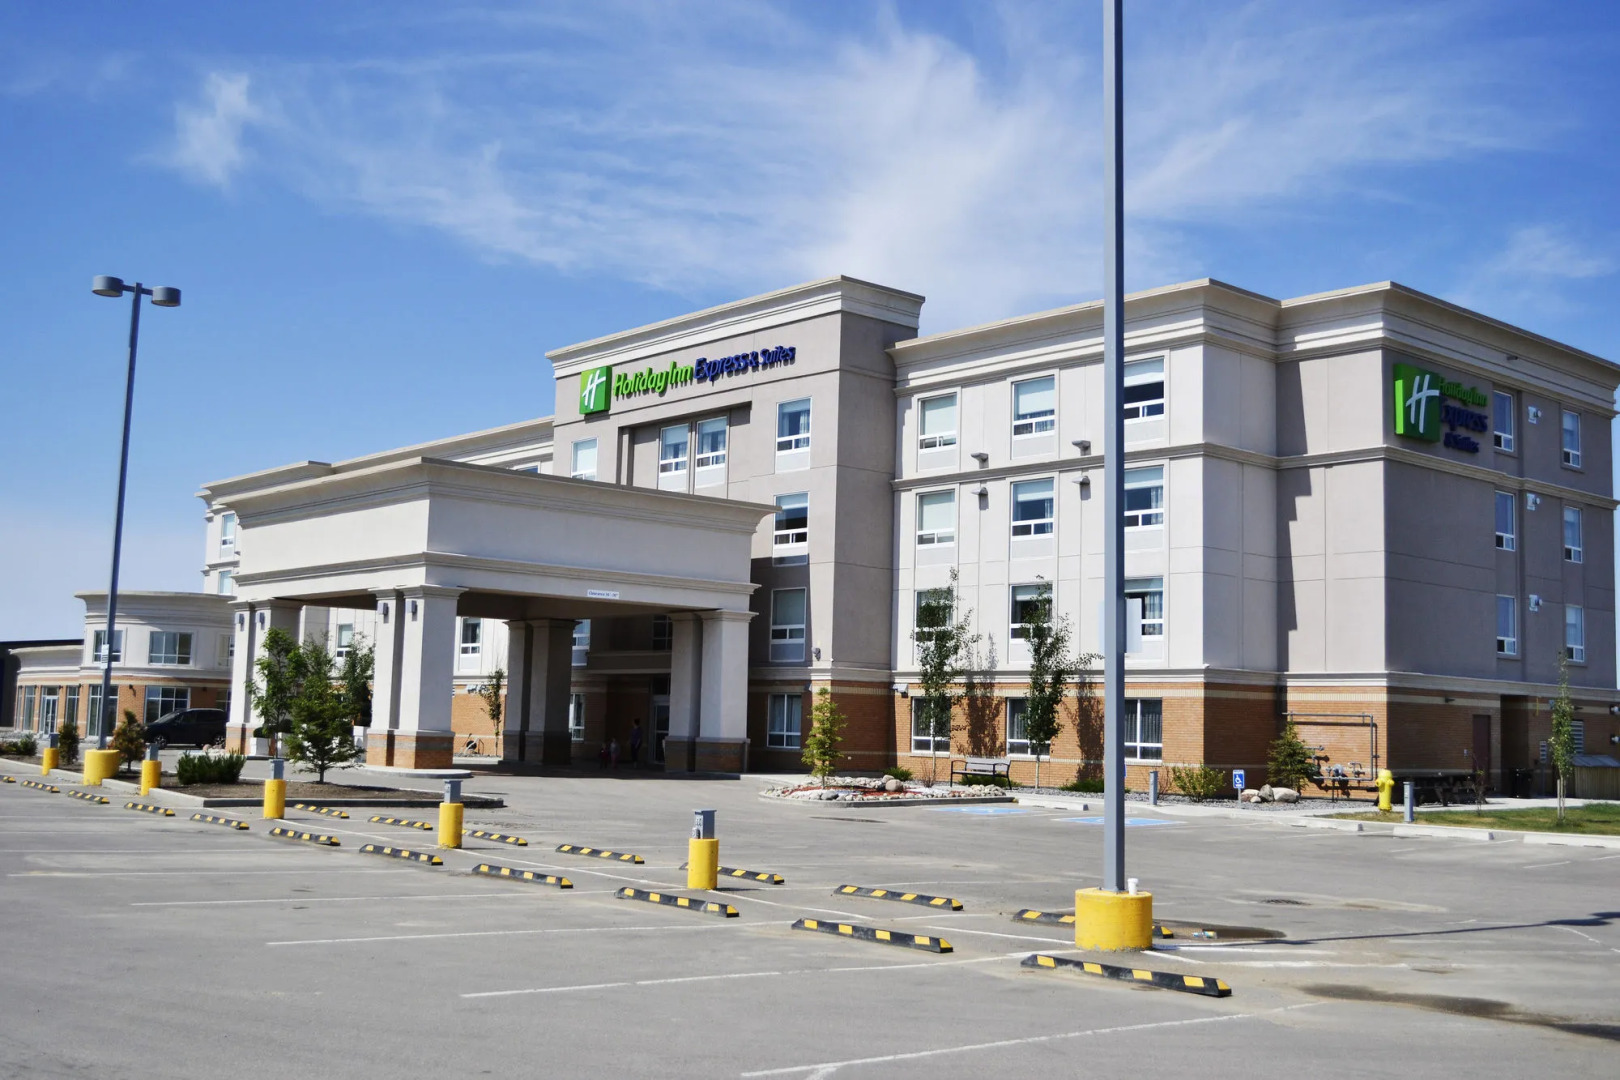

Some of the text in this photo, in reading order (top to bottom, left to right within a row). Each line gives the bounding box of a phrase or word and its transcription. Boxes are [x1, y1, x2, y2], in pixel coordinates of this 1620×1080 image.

[613, 346, 796, 396] Holiday Inn Express & Suites
